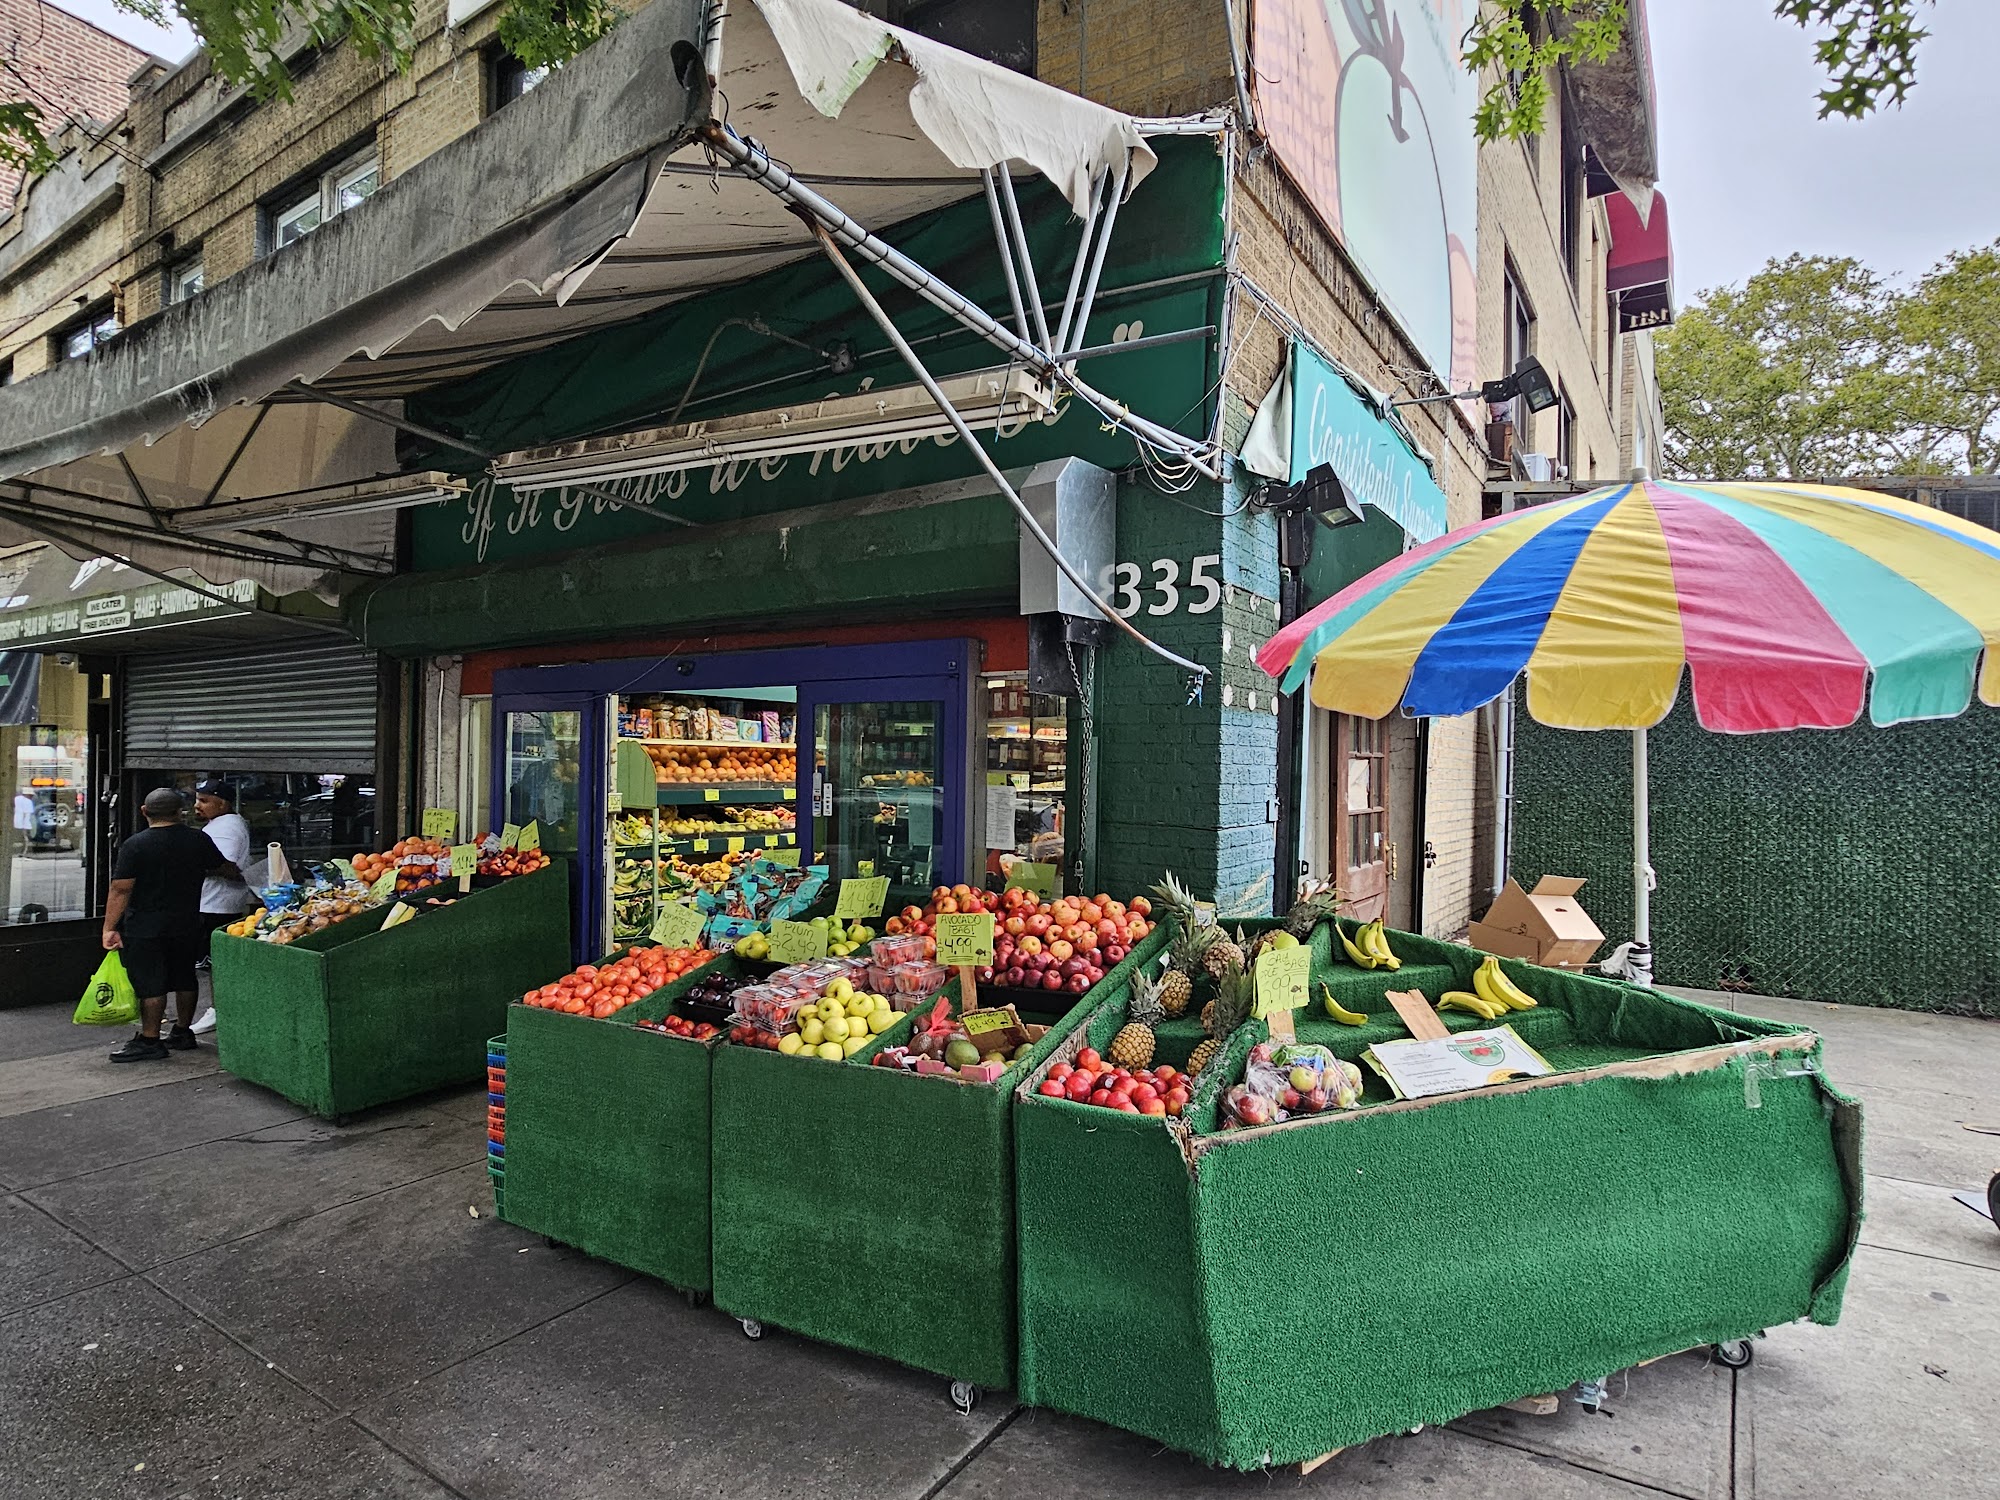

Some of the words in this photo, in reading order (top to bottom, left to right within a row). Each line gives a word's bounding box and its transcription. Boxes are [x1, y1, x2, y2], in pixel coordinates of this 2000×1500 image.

[1309, 383, 1398, 519] Consistently
[233, 579, 256, 604] PIZZA
[1113, 554, 1221, 619] 335
[90, 602, 99, 611] WE
[101, 599, 122, 610] CATER
[84, 619, 98, 630] FREE
[99, 616, 127, 628] DELIVERY
[846, 880, 881, 890] APPLES
[941, 915, 982, 925] AVOCADO
[782, 921, 814, 940] PLUM
[771, 932, 818, 957] $2.49
[938, 936, 973, 957] $4.99
